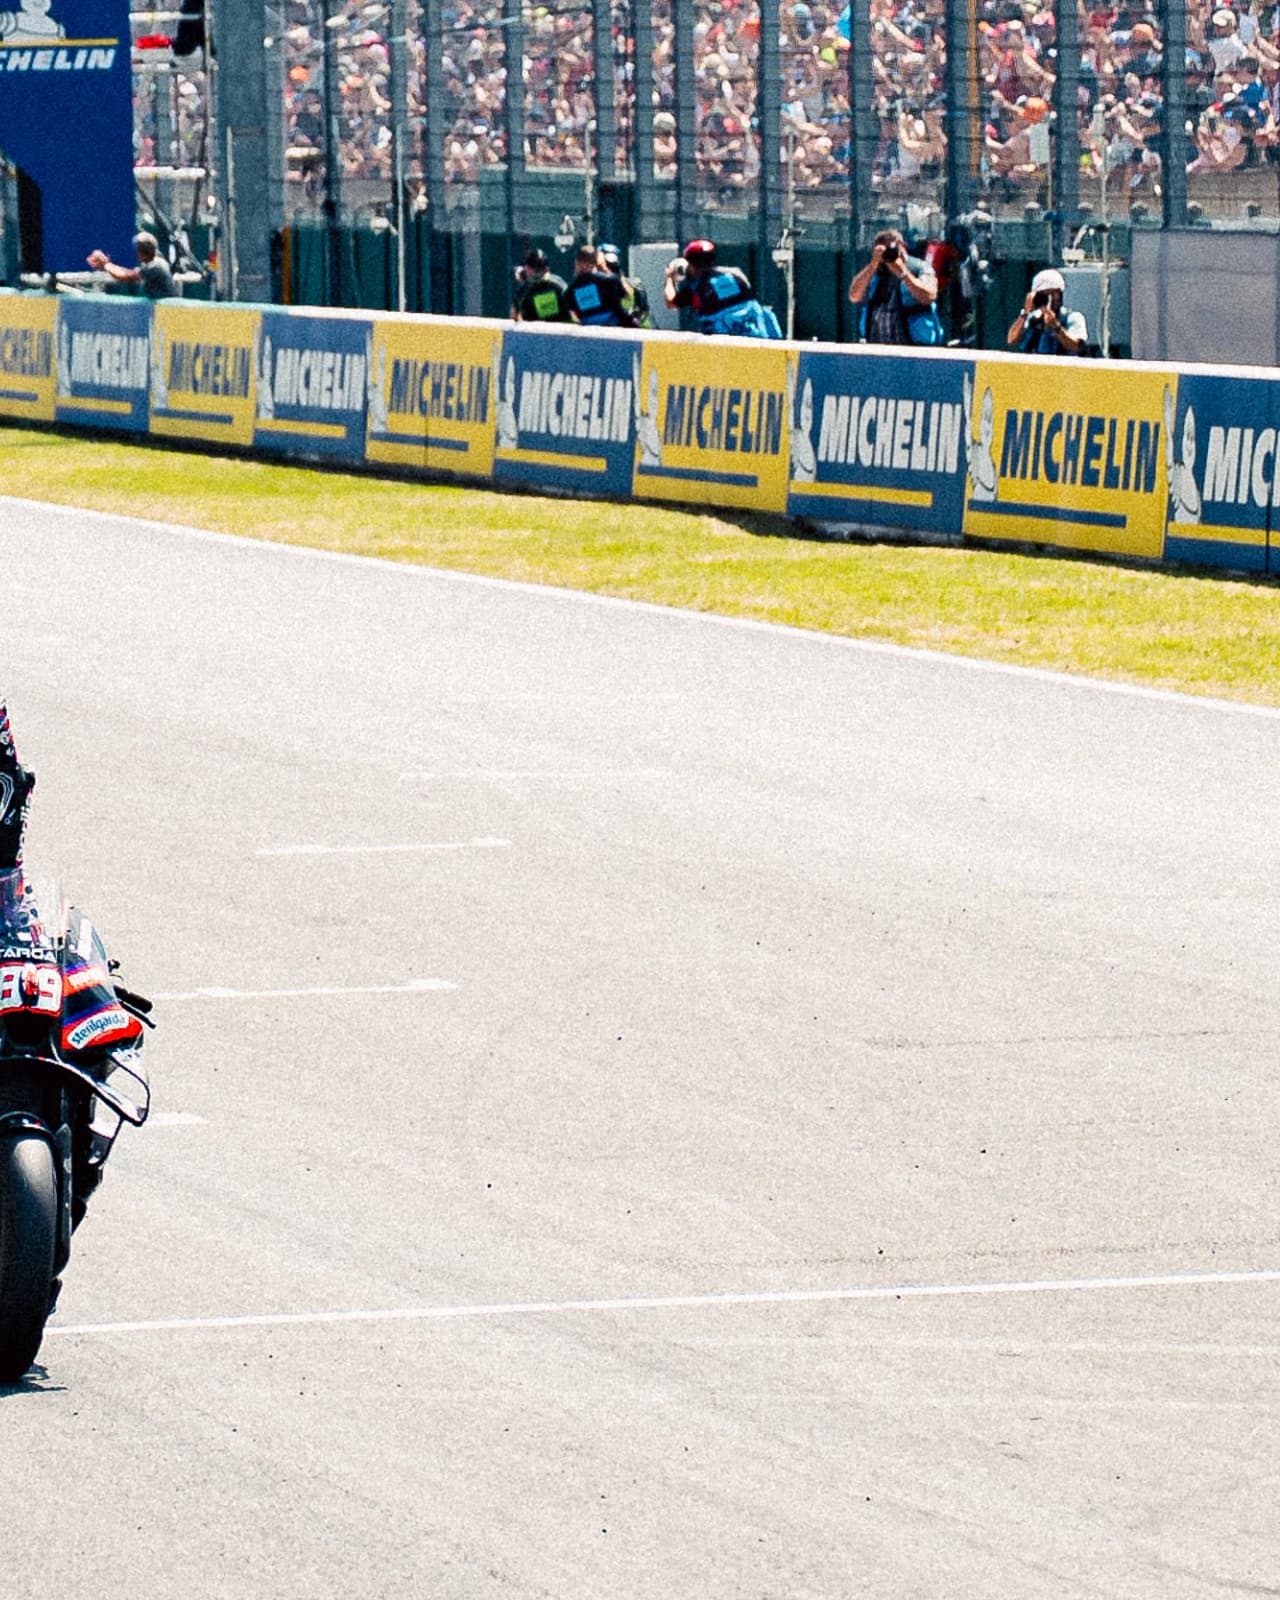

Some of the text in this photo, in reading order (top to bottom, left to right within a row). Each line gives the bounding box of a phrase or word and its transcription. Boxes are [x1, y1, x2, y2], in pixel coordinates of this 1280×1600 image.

[70, 331, 149, 389] MICHELIN
[168, 341, 251, 398] MICHELIN
[274, 347, 367, 412] MICHELIN
[389, 357, 491, 424] MICHELIN
[518, 370, 633, 443] MICHELIN
[663, 383, 785, 456] MICHELIN
[817, 394, 963, 474] MICHELIN
[999, 408, 1161, 494] MICHELIN
[1202, 425, 1280, 508] MIC
[71, 1012, 125, 1046] sterilgarda
